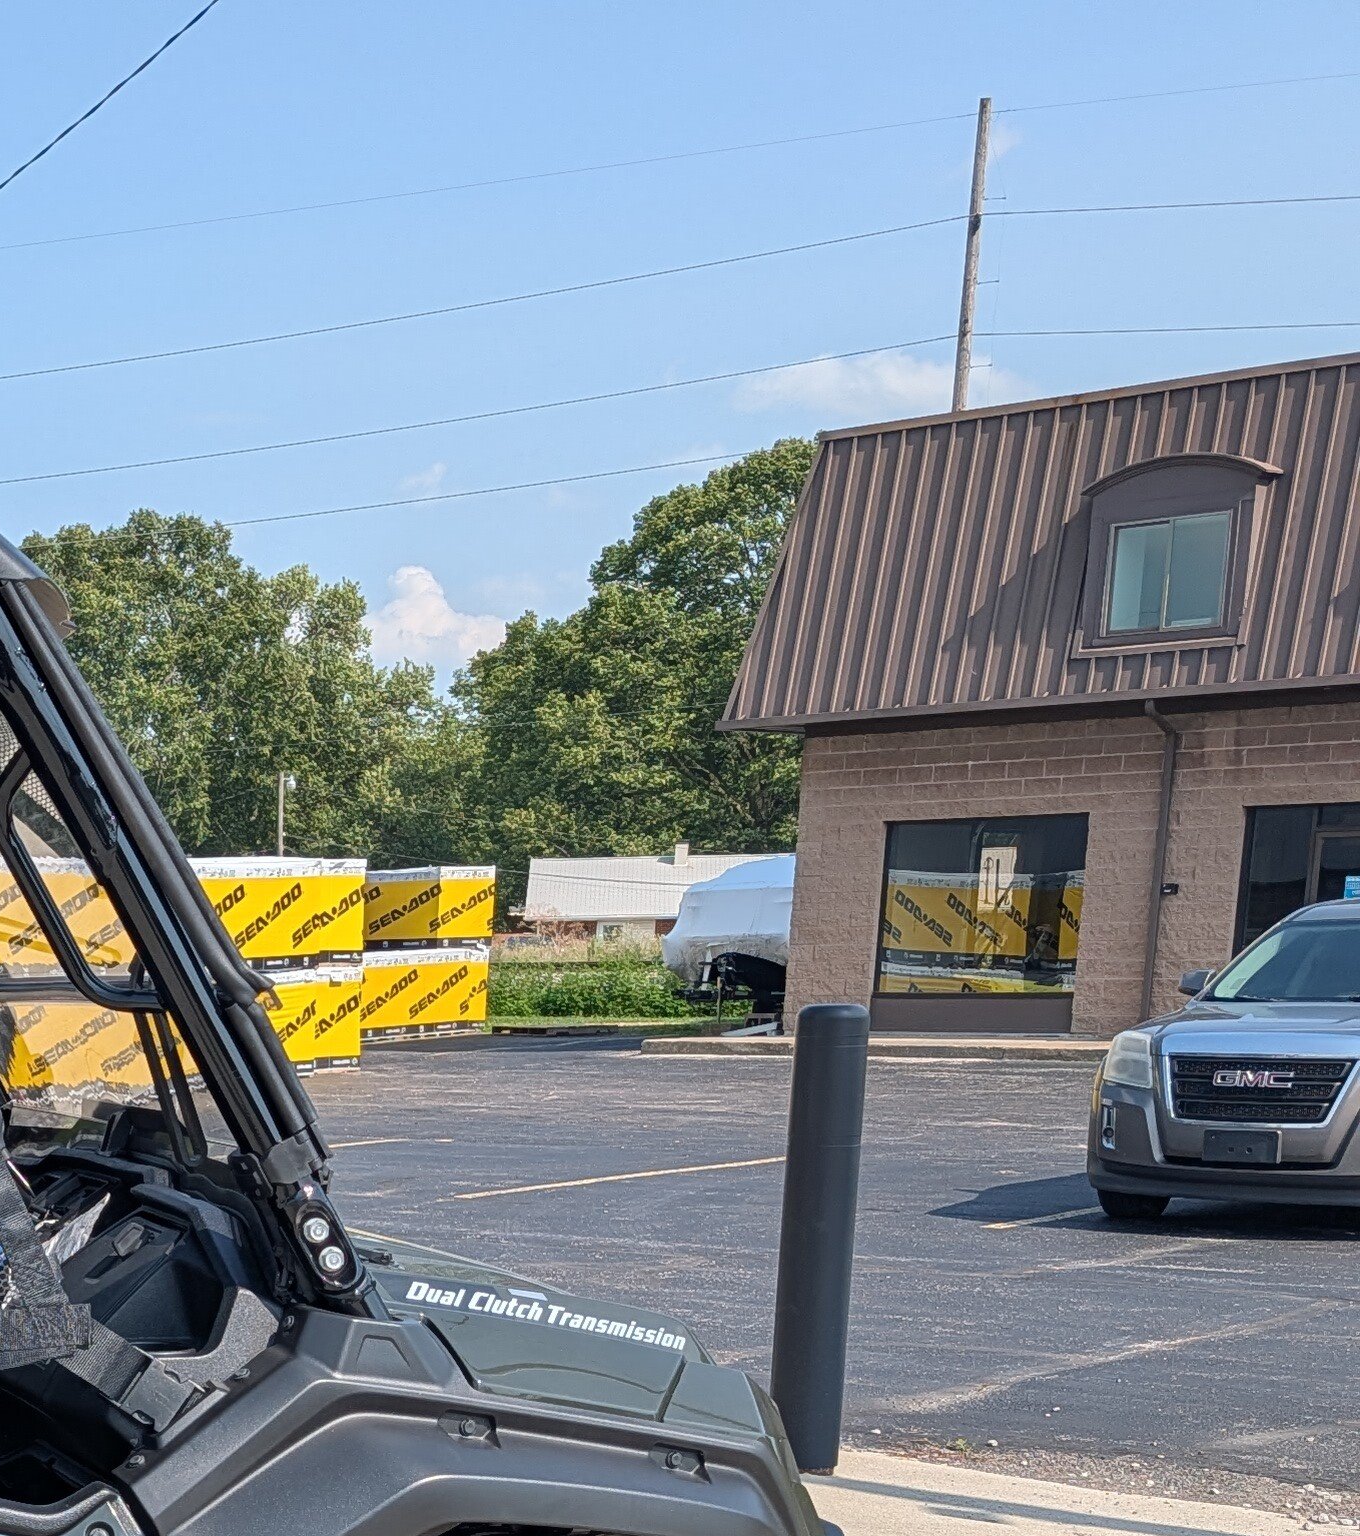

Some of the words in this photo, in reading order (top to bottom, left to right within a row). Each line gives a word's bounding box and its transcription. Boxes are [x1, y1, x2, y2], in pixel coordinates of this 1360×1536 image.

[1212, 1070, 1295, 1088] GMC
[406, 1281, 465, 1308] Dual
[468, 1291, 543, 1322] Clutch
[547, 1304, 686, 1351] Transmission
